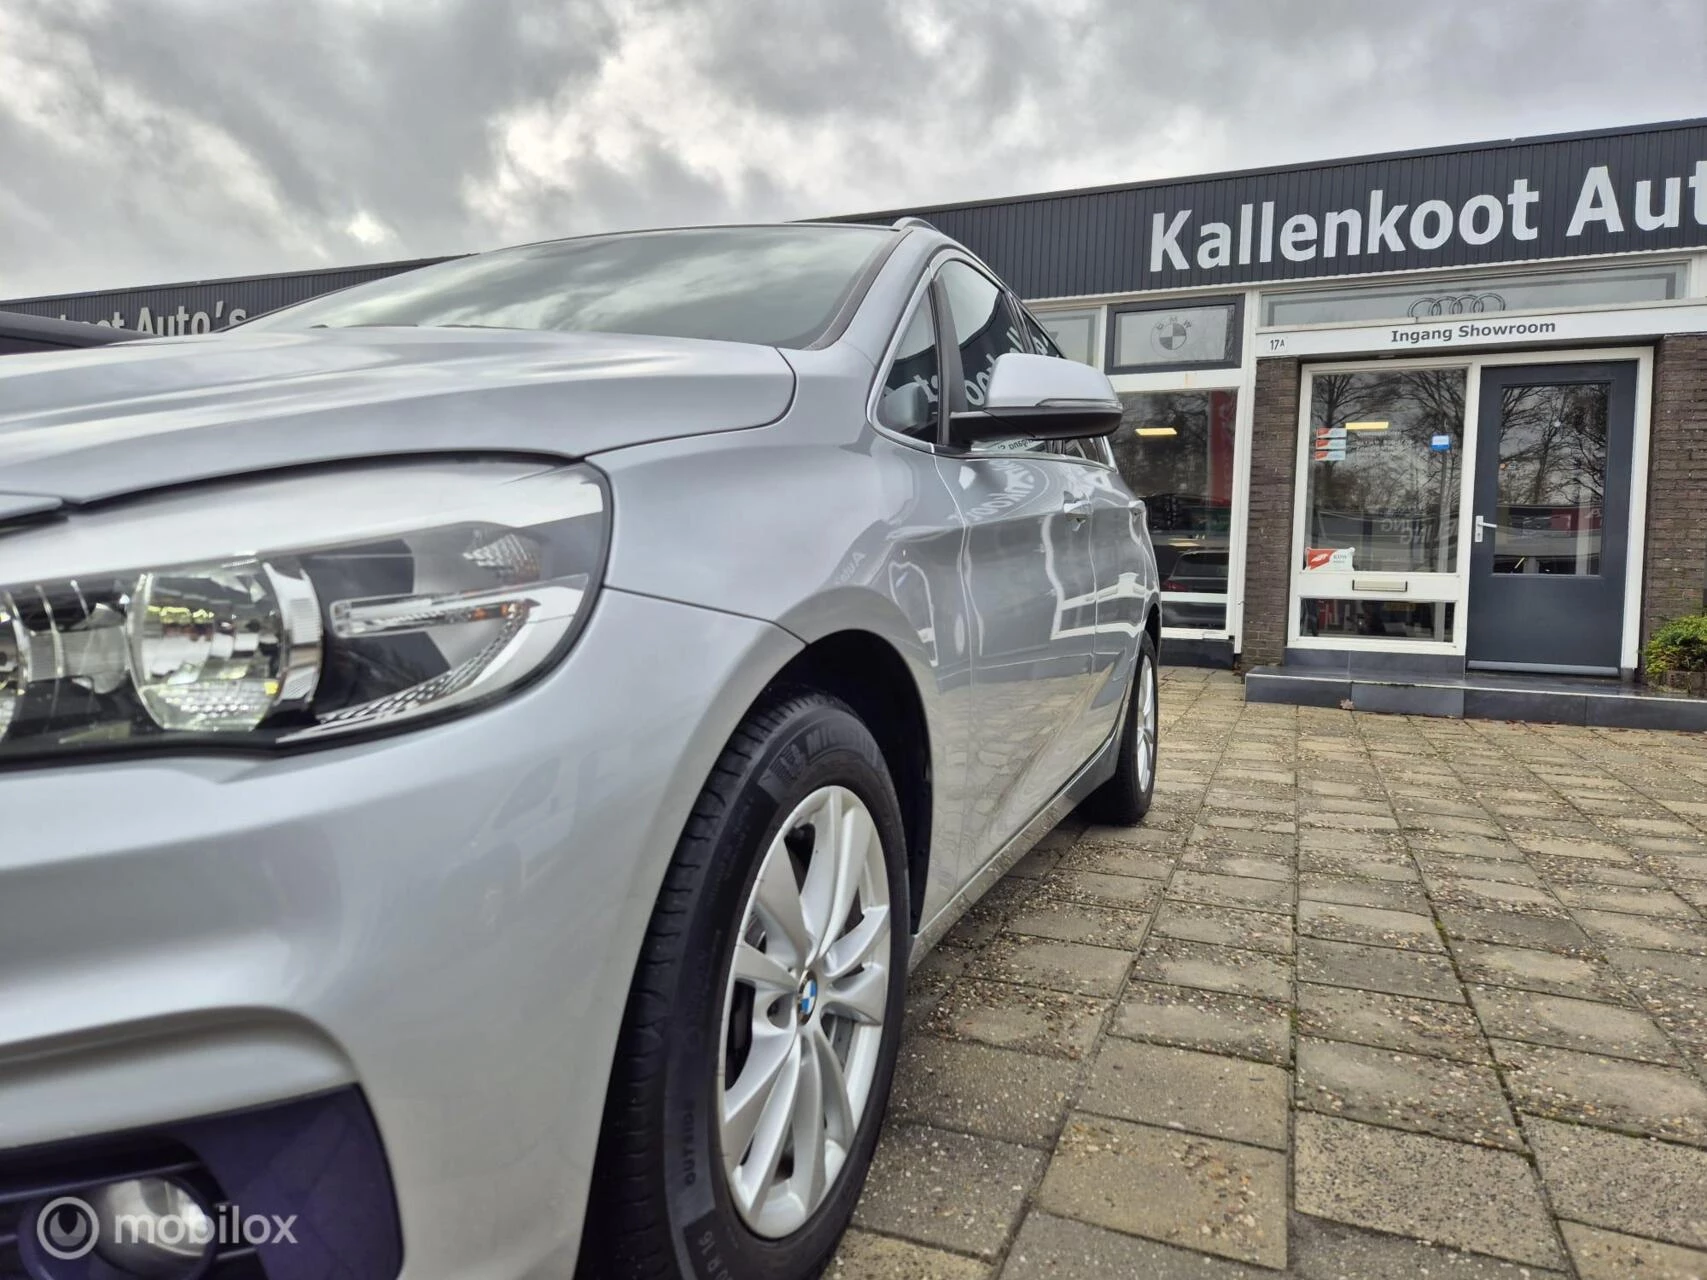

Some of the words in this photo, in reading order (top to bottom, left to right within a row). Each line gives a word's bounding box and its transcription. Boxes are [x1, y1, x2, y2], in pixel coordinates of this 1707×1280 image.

[1149, 178, 1540, 273] Kallenkoot
[1391, 328, 1452, 344] Ingang
[1458, 321, 1556, 338] Showroom
